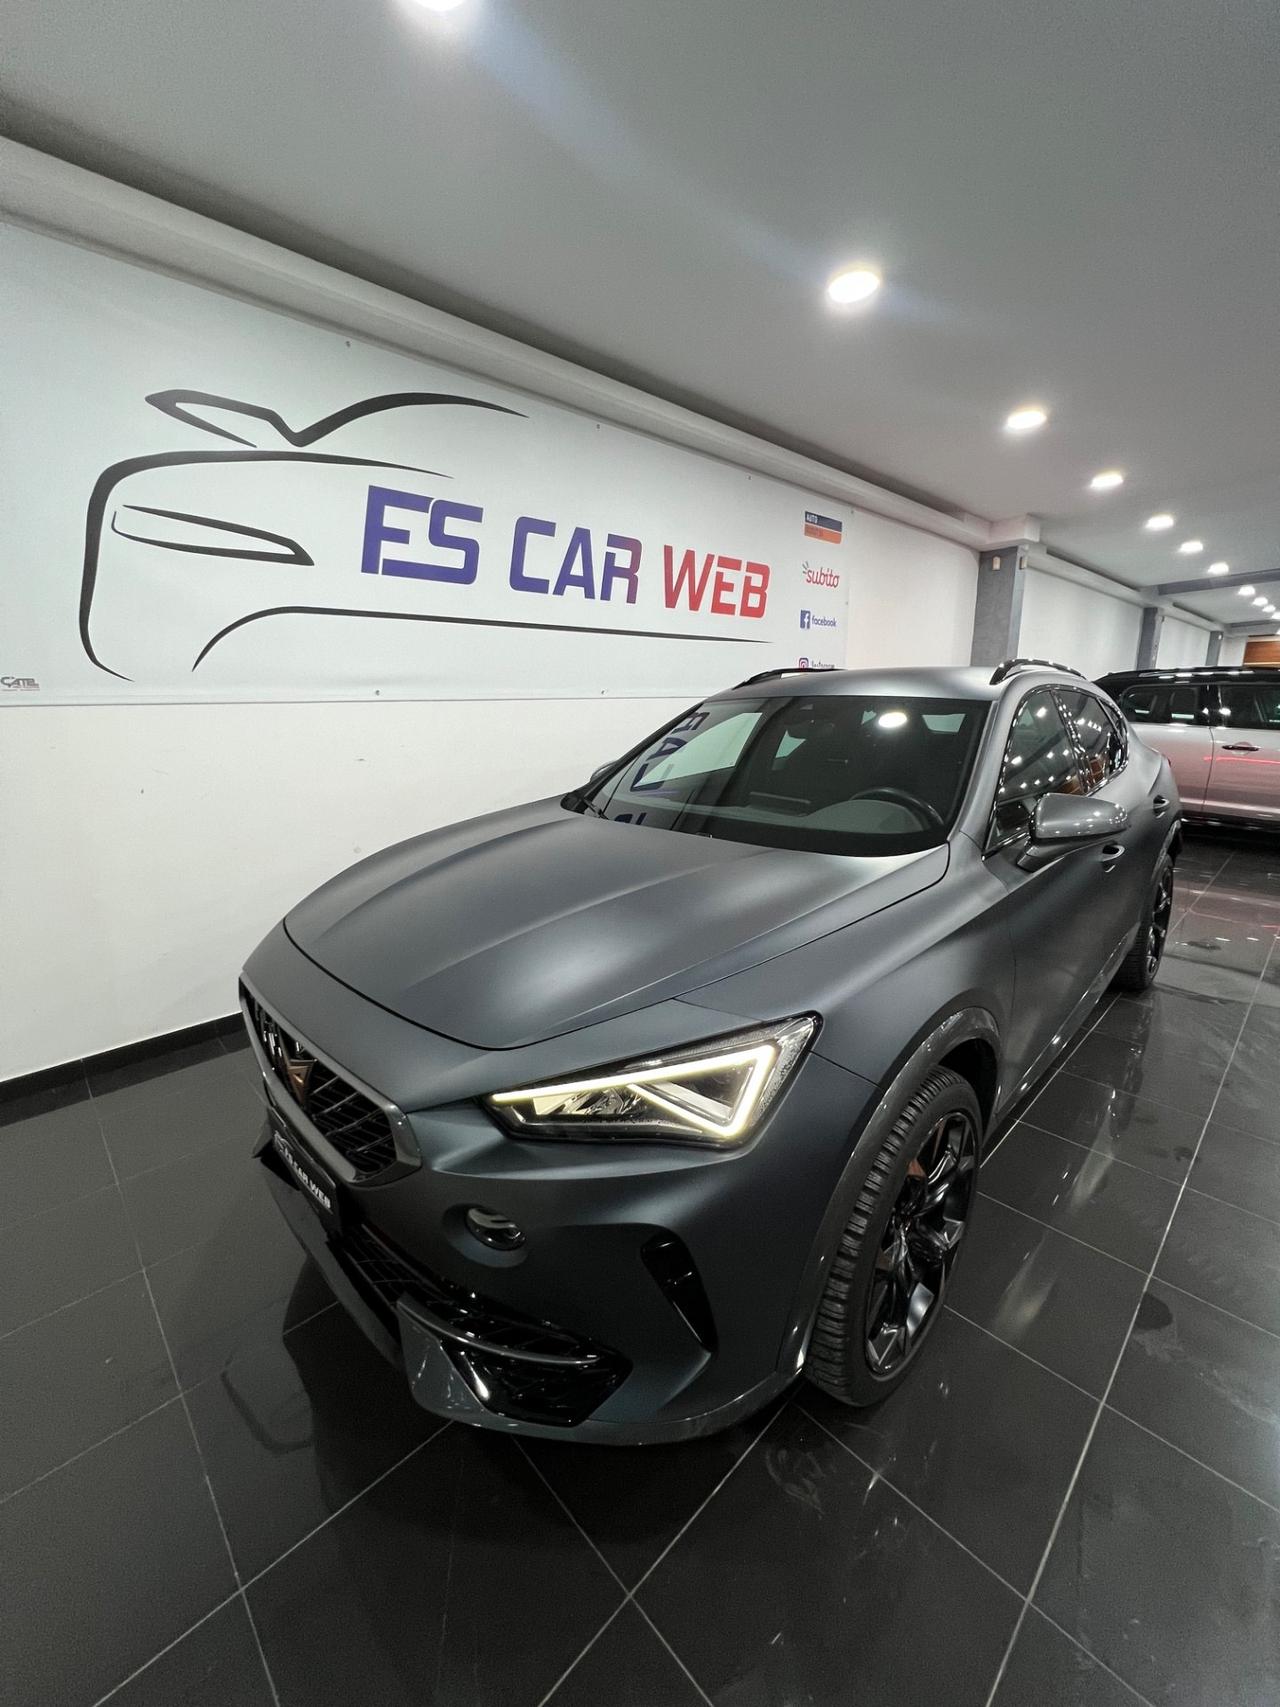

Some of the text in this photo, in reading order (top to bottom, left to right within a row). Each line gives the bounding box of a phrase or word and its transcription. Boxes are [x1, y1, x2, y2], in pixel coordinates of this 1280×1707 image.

[360, 484, 771, 619] ES CAR WEB
[806, 566, 840, 588] subito
[811, 615, 836, 627] facebook
